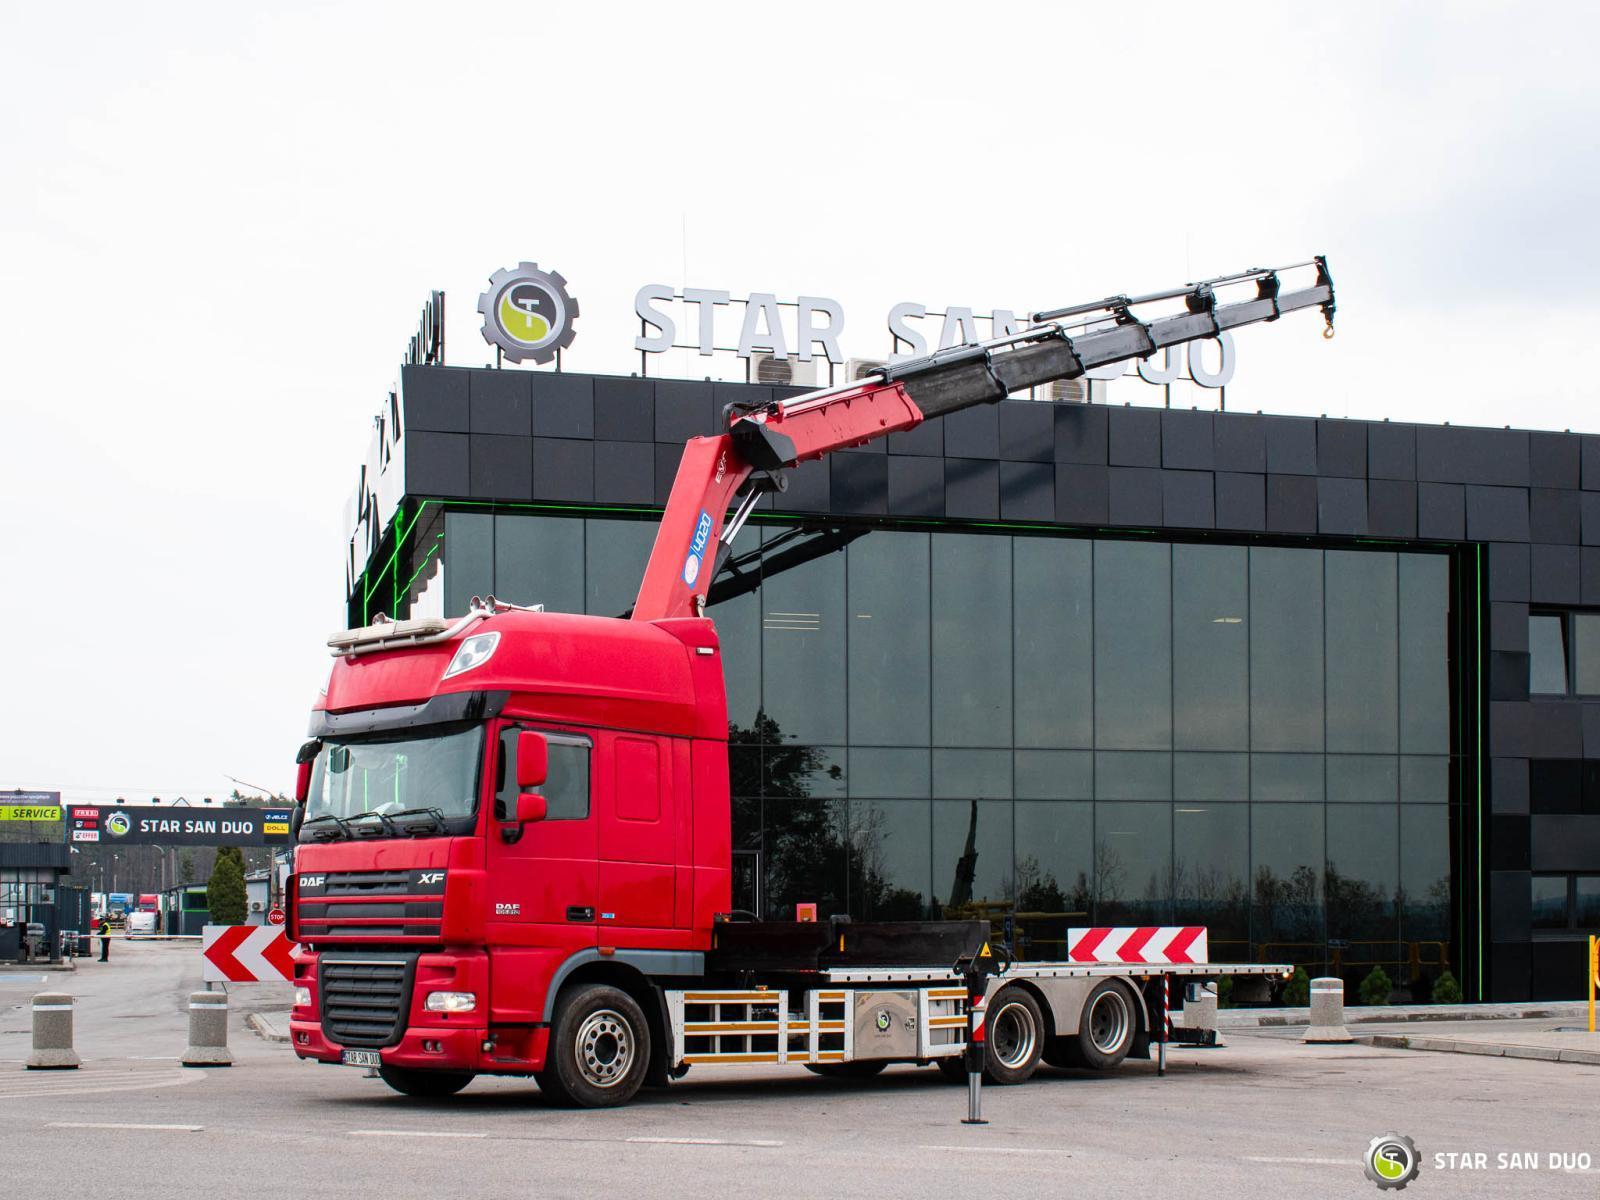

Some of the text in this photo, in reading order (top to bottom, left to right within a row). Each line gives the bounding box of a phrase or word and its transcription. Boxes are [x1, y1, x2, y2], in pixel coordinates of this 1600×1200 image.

[634, 284, 845, 364] STAR
[693, 512, 712, 552] 4020
[12, 809, 57, 818] SERVICE
[140, 819, 253, 834] STAR SAN DUO
[299, 876, 325, 887] DAF
[418, 873, 445, 884] XF
